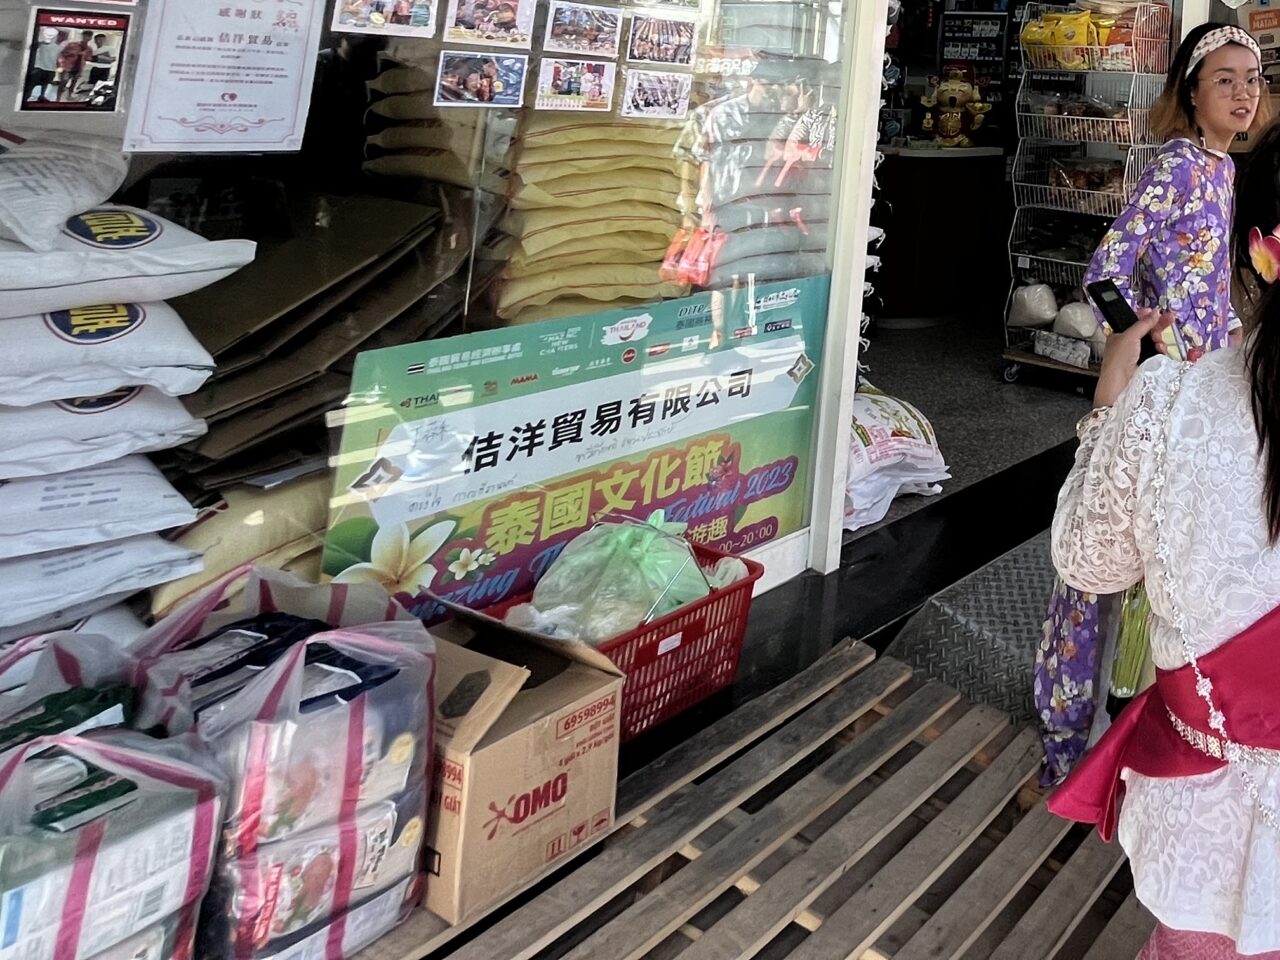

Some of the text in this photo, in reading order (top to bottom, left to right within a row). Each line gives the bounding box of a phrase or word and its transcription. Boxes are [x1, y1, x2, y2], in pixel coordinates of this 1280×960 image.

[50, 16, 118, 26] WANTED
[511, 374, 539, 385] MAMA
[461, 368, 754, 474] 佶洋貿易有限公司
[484, 442, 726, 558] 泰國文化節
[743, 462, 794, 500] 2023
[564, 695, 615, 731] 69598994
[513, 772, 569, 824] OMO
